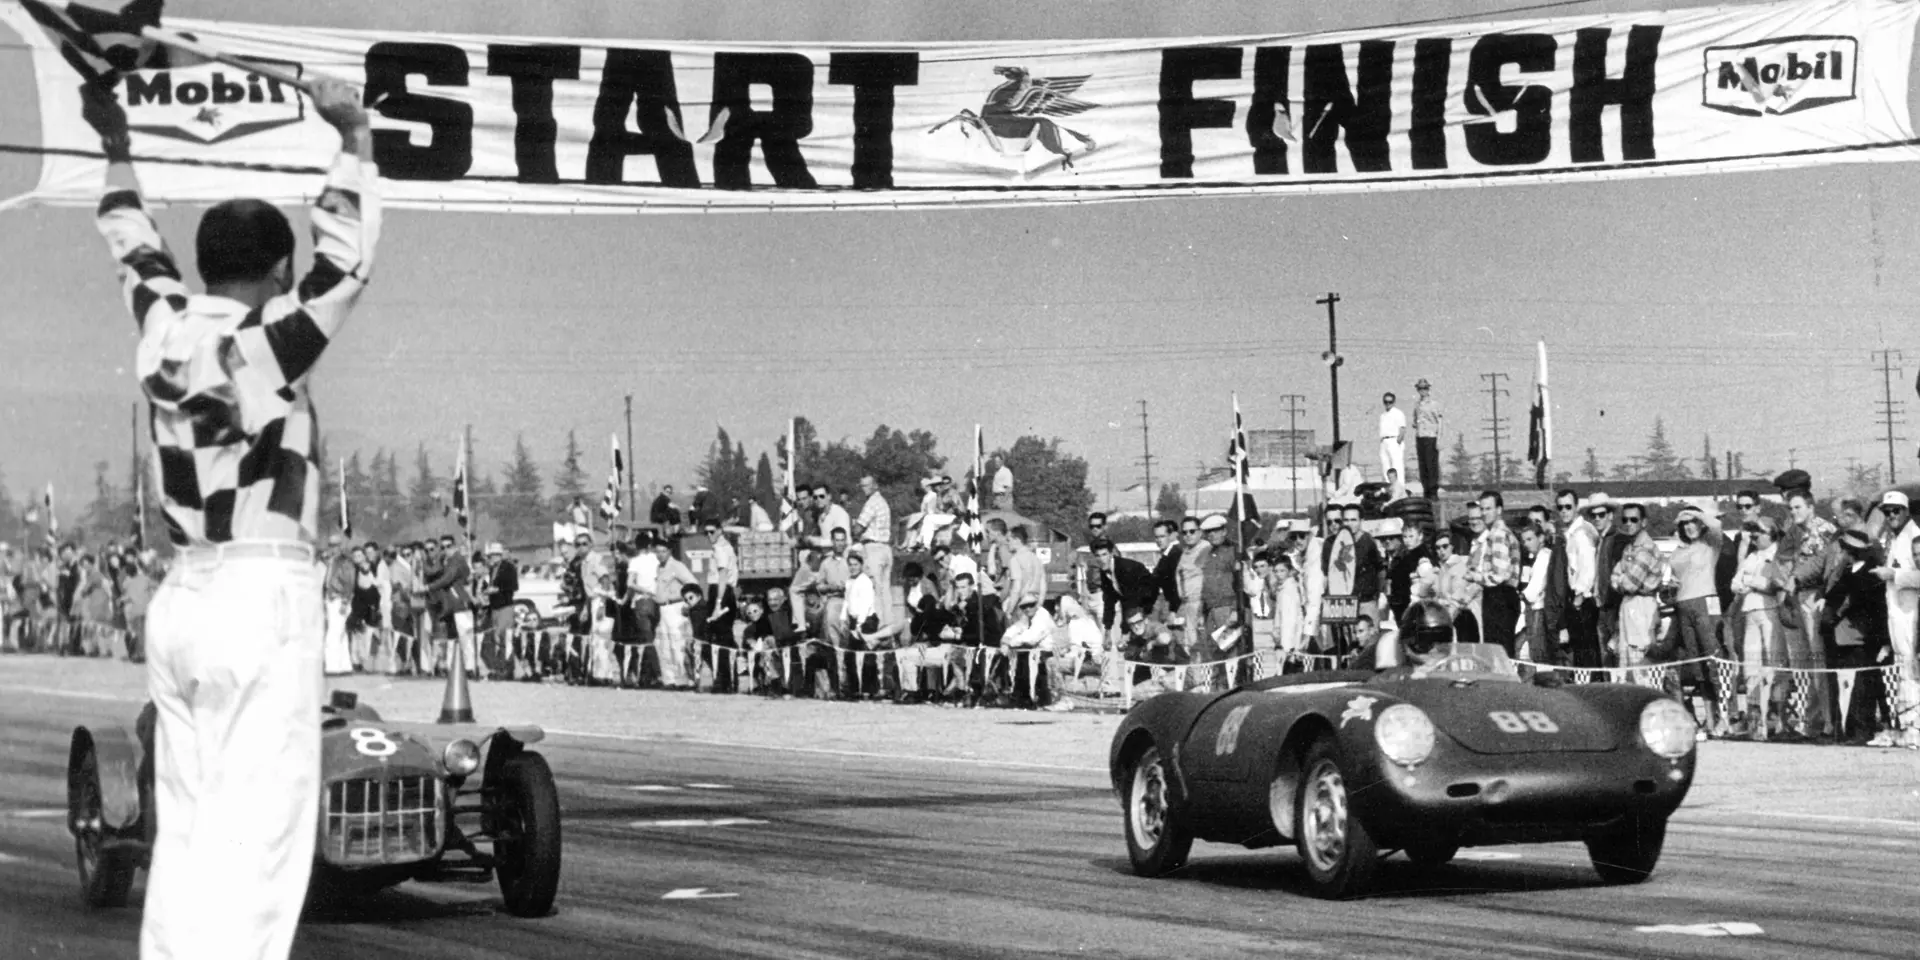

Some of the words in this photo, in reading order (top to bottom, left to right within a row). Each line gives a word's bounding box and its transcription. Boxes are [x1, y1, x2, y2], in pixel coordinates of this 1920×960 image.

[127, 71, 285, 106] Mobil
[1718, 50, 1842, 92] Mobil
[363, 42, 919, 190] START
[1157, 25, 1664, 178] FINISH
[1488, 711, 1559, 733] 88
[350, 728, 397, 756] 8
